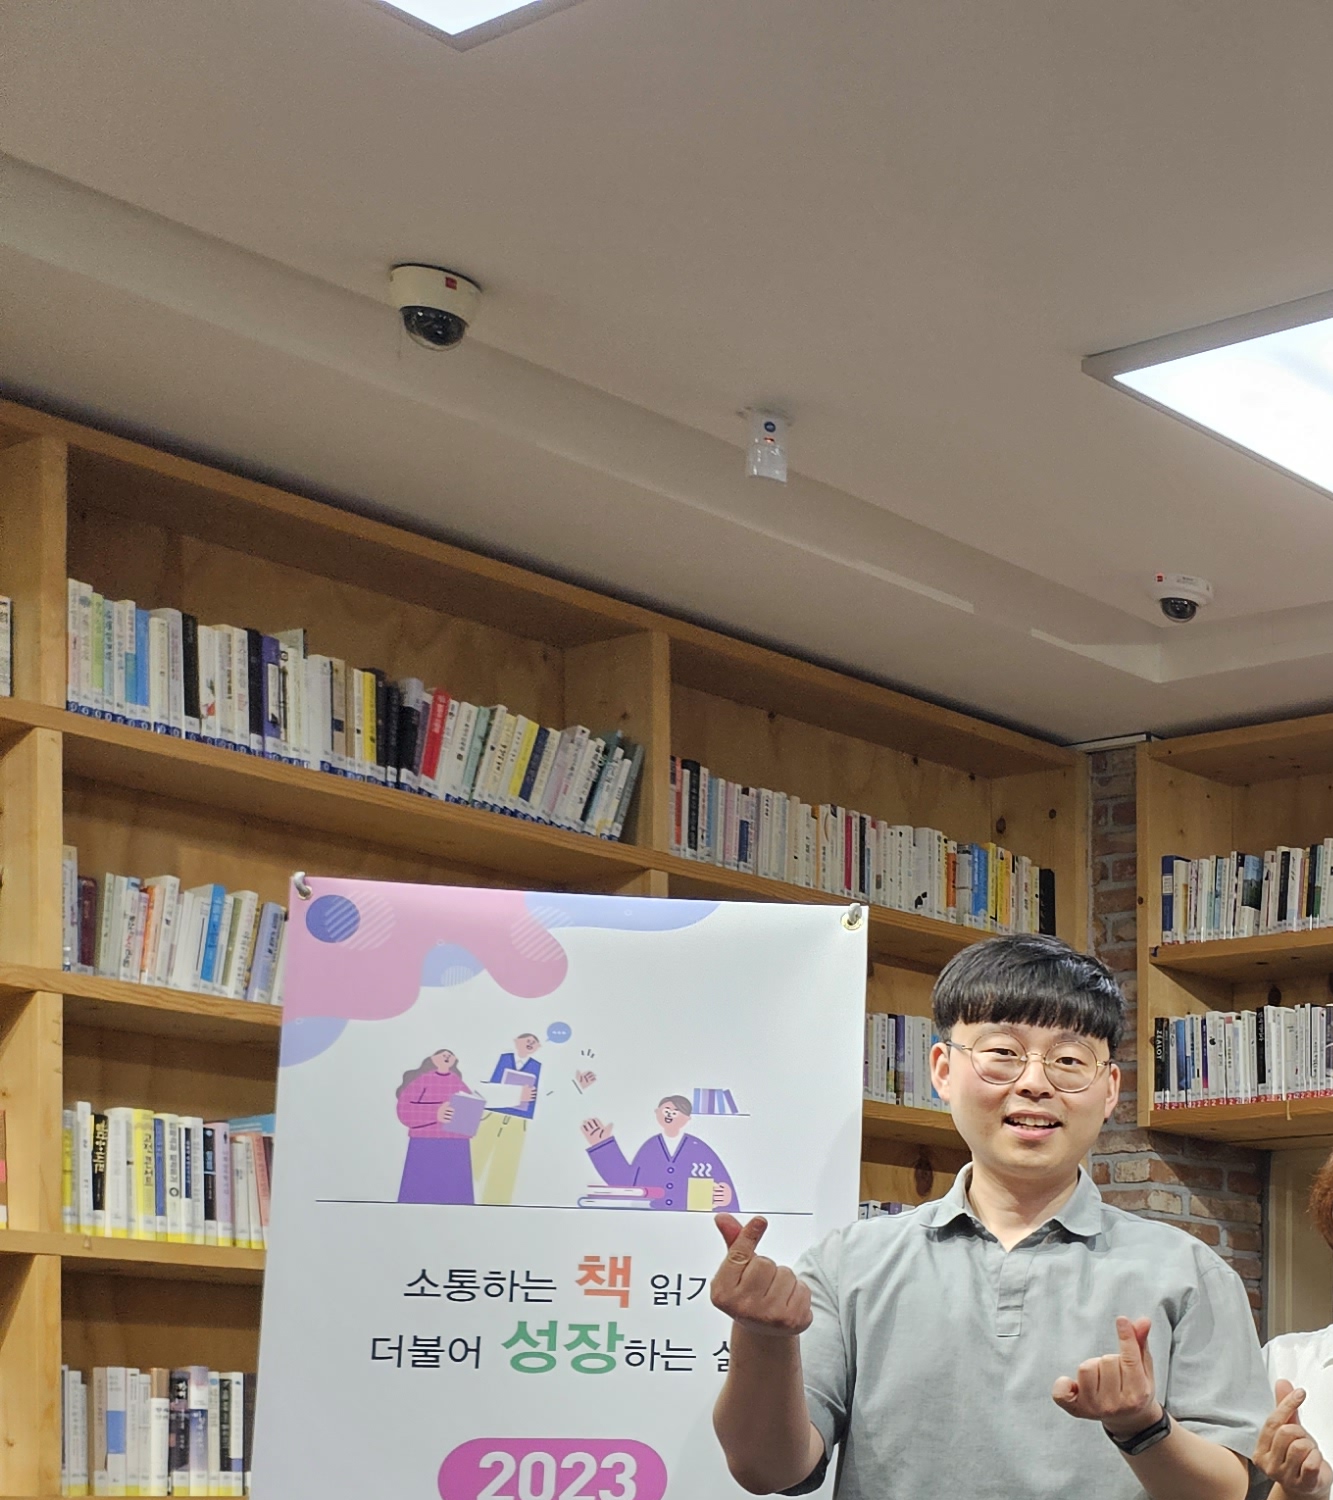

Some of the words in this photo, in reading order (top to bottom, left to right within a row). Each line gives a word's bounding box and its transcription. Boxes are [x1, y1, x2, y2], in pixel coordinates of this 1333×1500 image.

[403, 1268, 558, 1304] 소통하는
[574, 1255, 633, 1309] 책
[370, 1334, 483, 1370] 더불어
[500, 1318, 697, 1375] 성장하는
